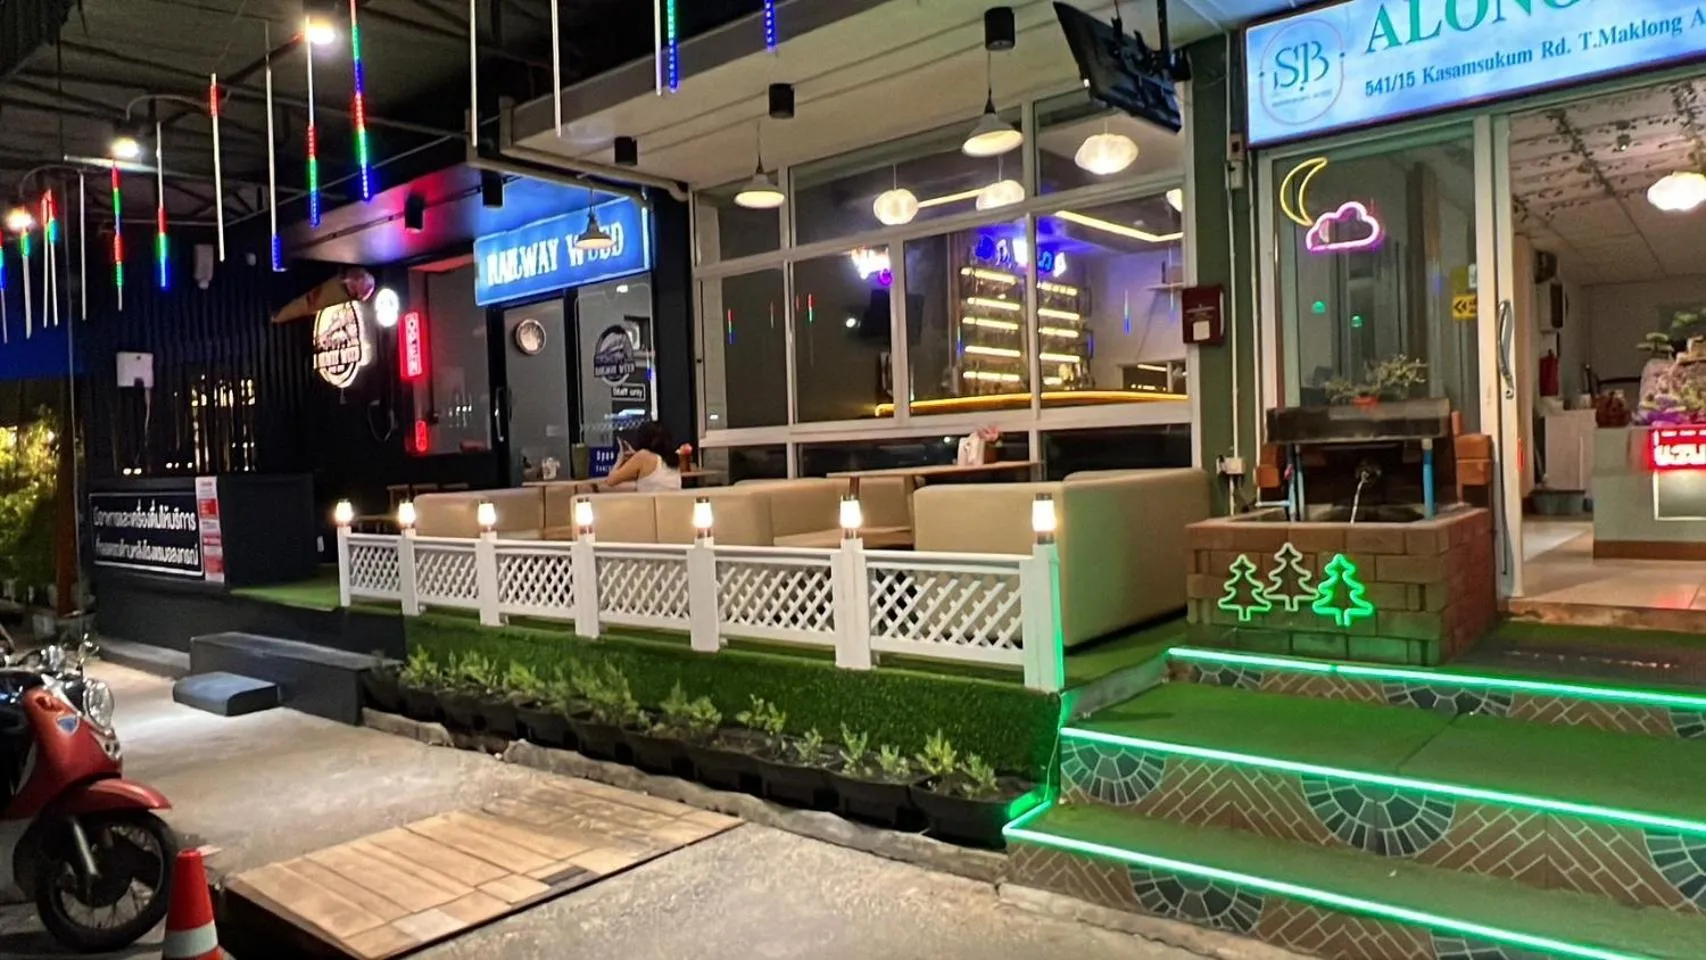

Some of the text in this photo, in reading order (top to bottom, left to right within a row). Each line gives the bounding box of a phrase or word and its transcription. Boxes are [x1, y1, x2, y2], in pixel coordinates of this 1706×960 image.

[1363, 0, 1582, 54] ALO
[1365, 72, 1415, 97] 541/15
[1423, 50, 1533, 86] Kasamsukum
[1541, 37, 1571, 60] Rd.
[1578, 15, 1683, 50] T.Maklong
[487, 238, 560, 286] RAILWAY
